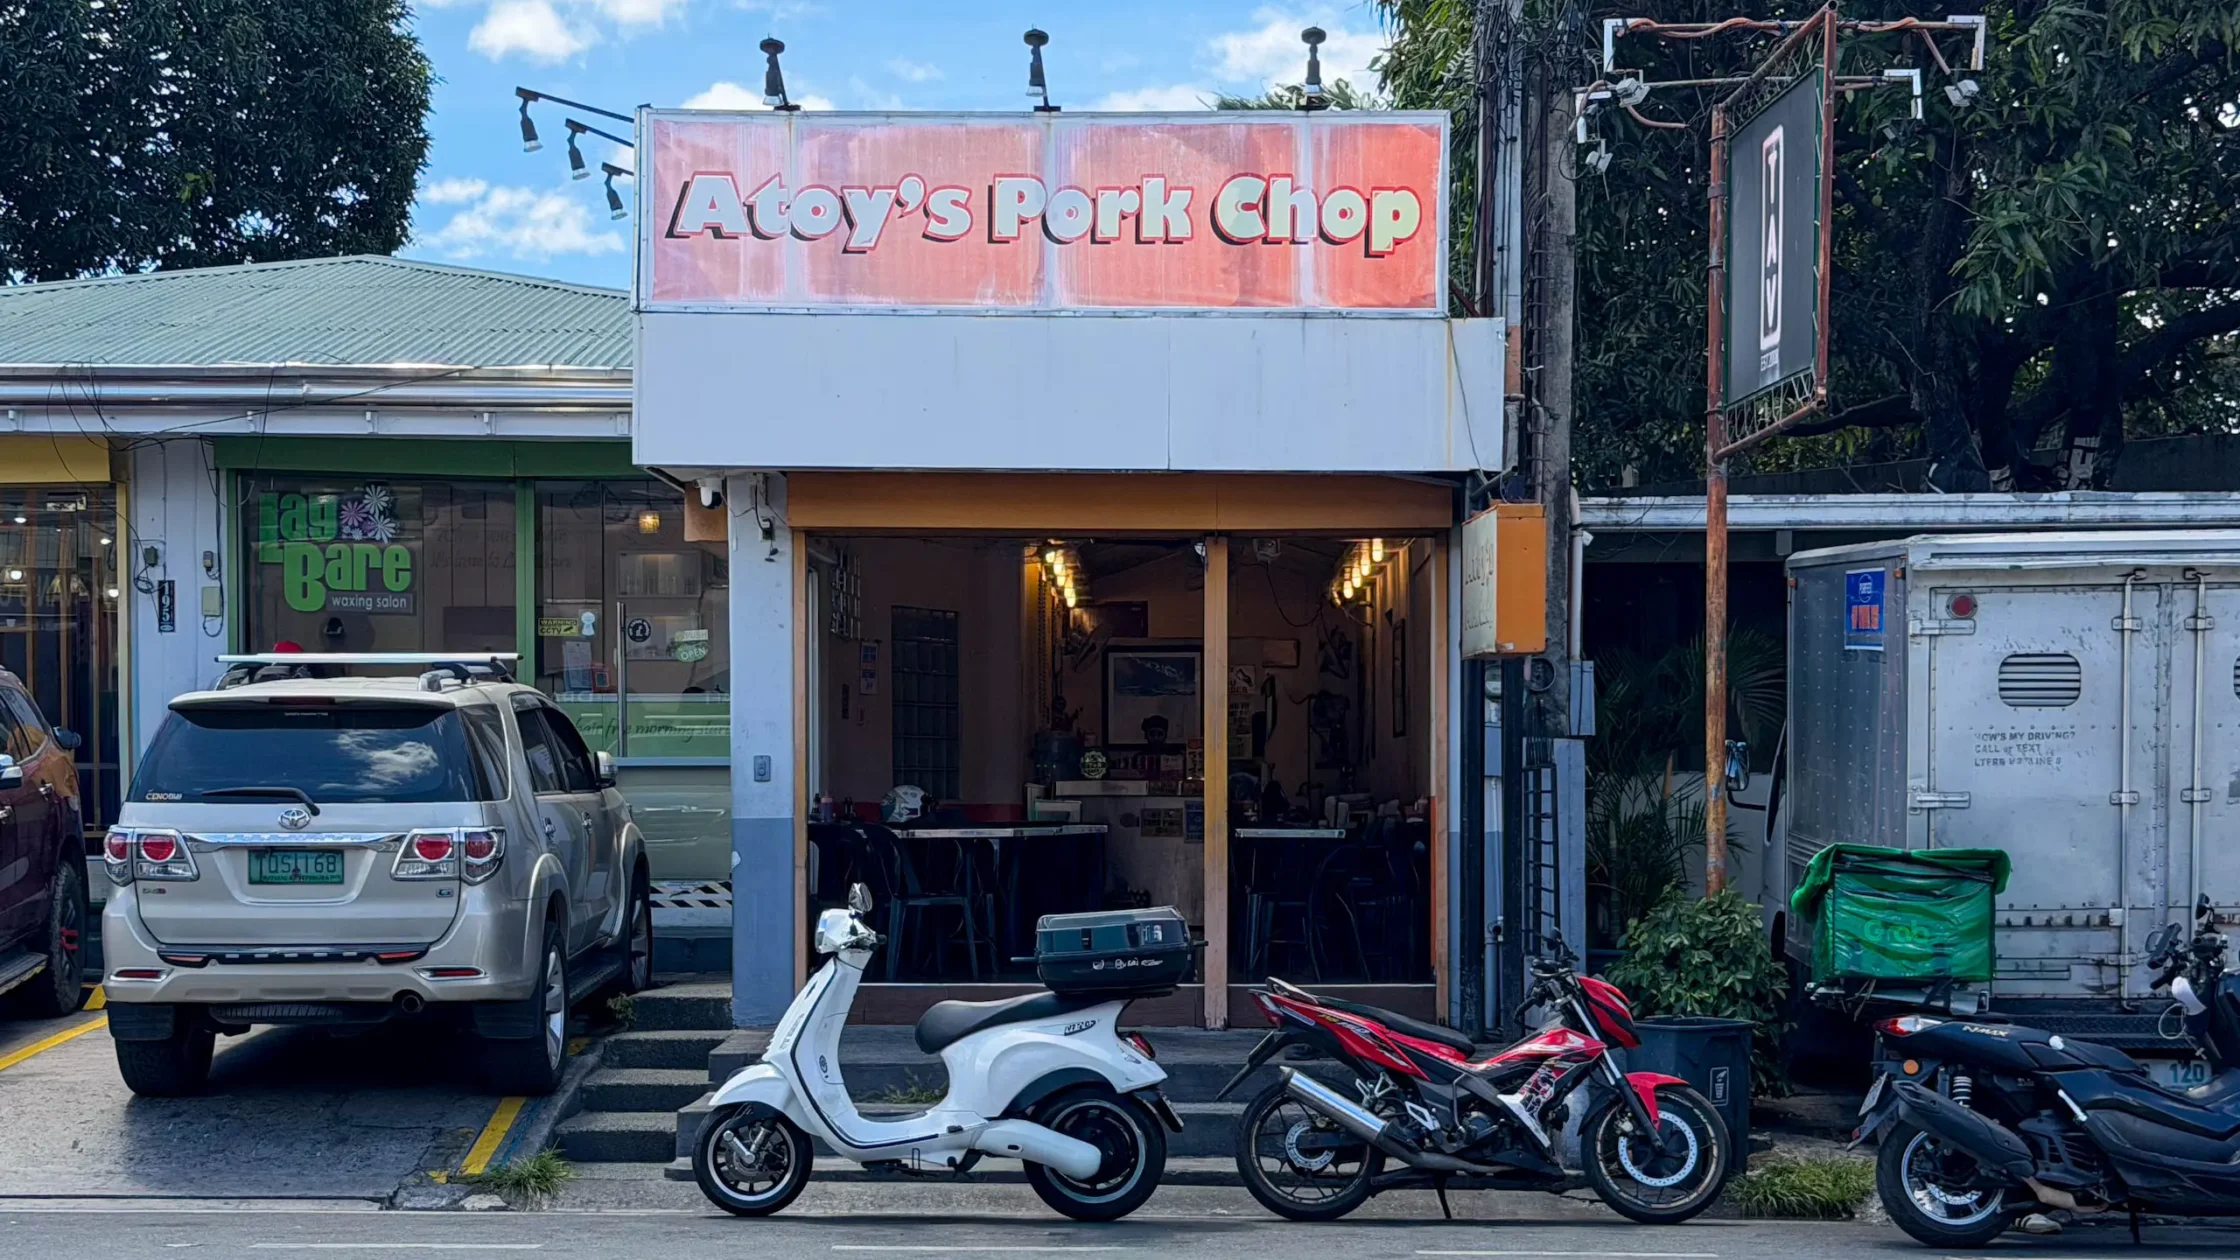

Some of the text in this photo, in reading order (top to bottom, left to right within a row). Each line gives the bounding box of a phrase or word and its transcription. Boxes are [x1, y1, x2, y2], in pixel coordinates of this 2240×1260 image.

[668, 172, 1422, 255] Atoy's Pork Chop
[284, 542, 412, 612] Bare
[332, 594, 407, 611] waxing salon
[540, 619, 578, 627] WARNING
[540, 627, 562, 635] CCTV
[680, 647, 707, 661] OPEN
[605, 717, 632, 740] fre
[2009, 732, 2025, 741] MY
[2028, 731, 2076, 741] DRIVNG?
[1975, 744, 2000, 754] CALL
[2016, 743, 2041, 754] TEXT
[303, 854, 338, 874] 168
[1864, 919, 1930, 943] Grab
[2168, 1063, 2205, 1084] 120
